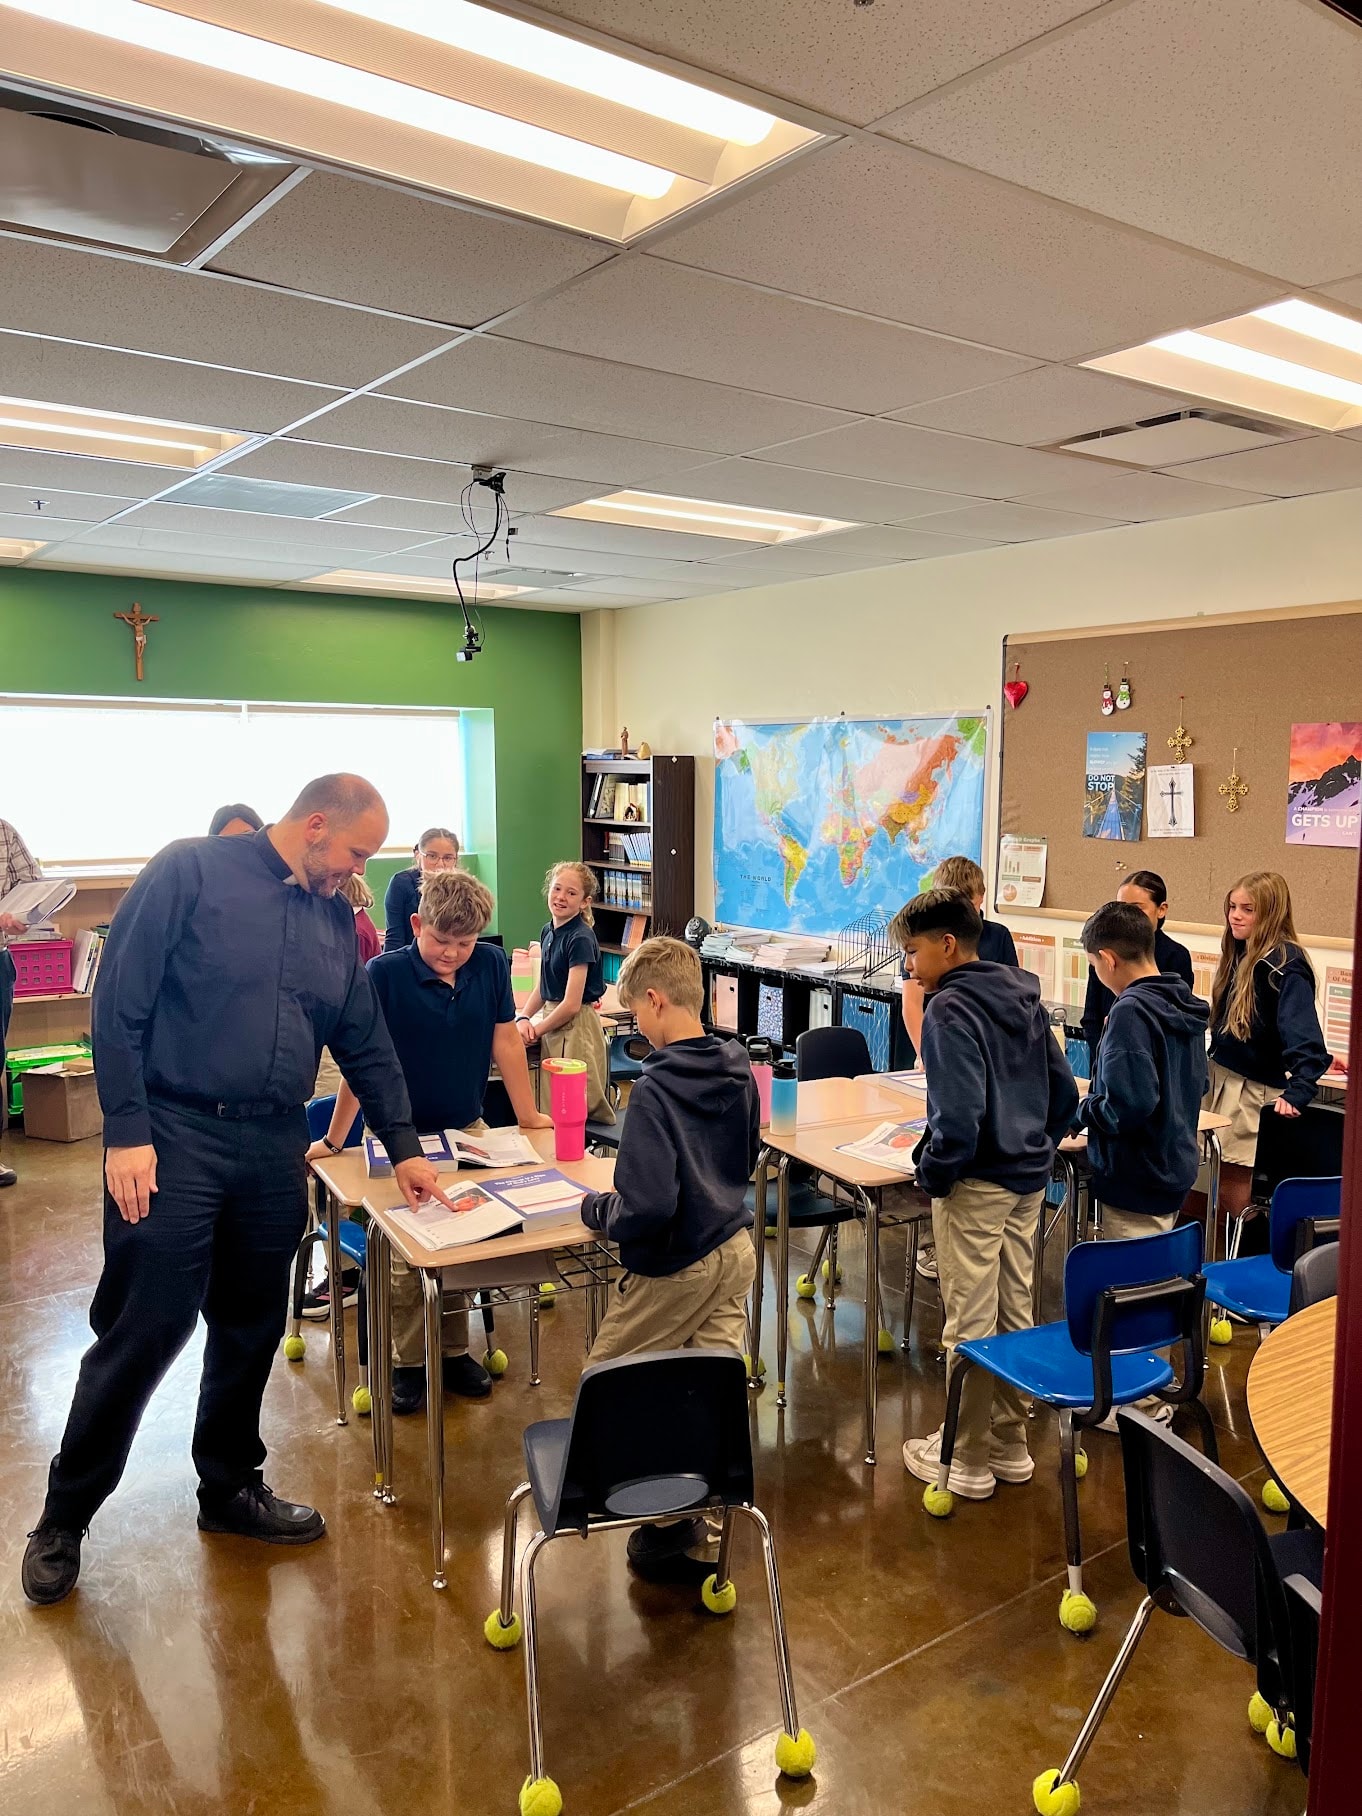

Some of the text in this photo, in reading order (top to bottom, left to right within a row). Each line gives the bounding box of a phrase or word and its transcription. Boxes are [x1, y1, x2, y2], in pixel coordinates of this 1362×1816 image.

[1088, 782, 1114, 791] STOP
[1291, 813, 1358, 828] GETS UP
